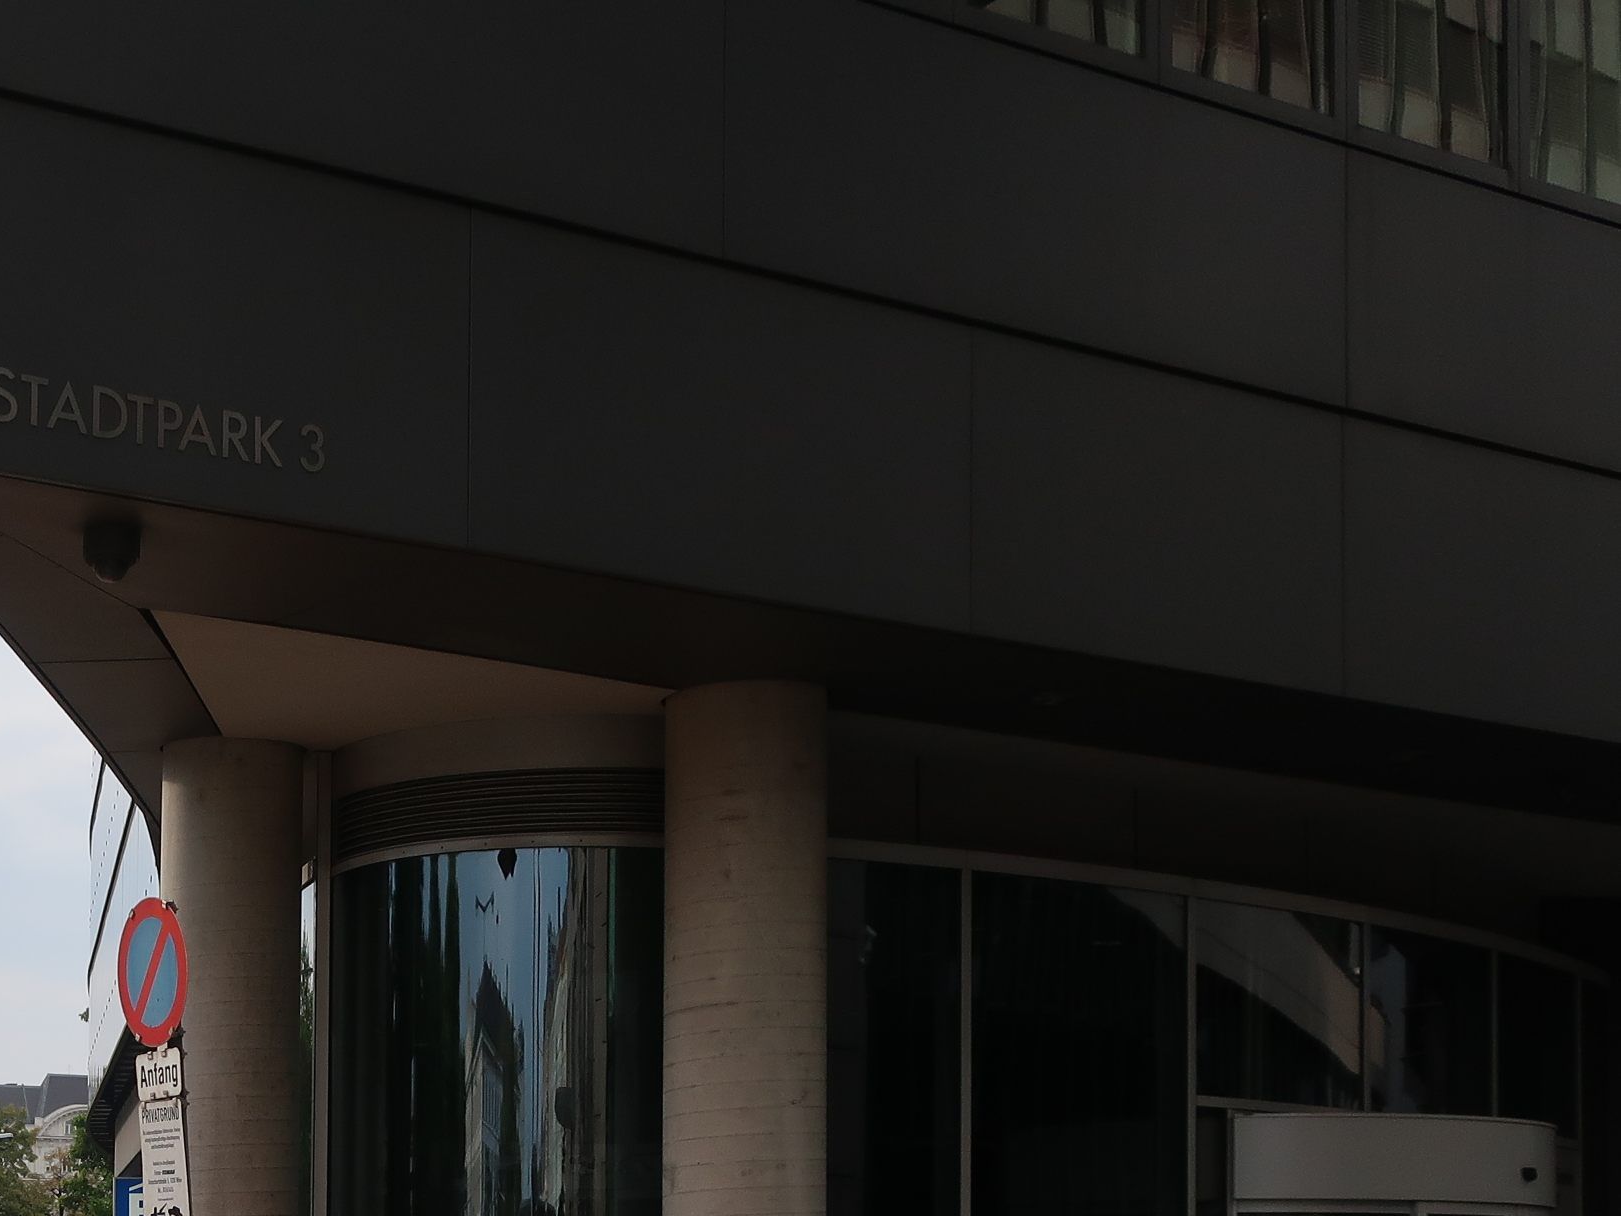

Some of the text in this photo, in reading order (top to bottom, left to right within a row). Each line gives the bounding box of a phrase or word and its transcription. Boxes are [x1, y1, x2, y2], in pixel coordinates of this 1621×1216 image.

[298, 424, 327, 474] 3
[140, 1063, 178, 1088] Anfang
[142, 1106, 180, 1124] PRIVATGRUND
